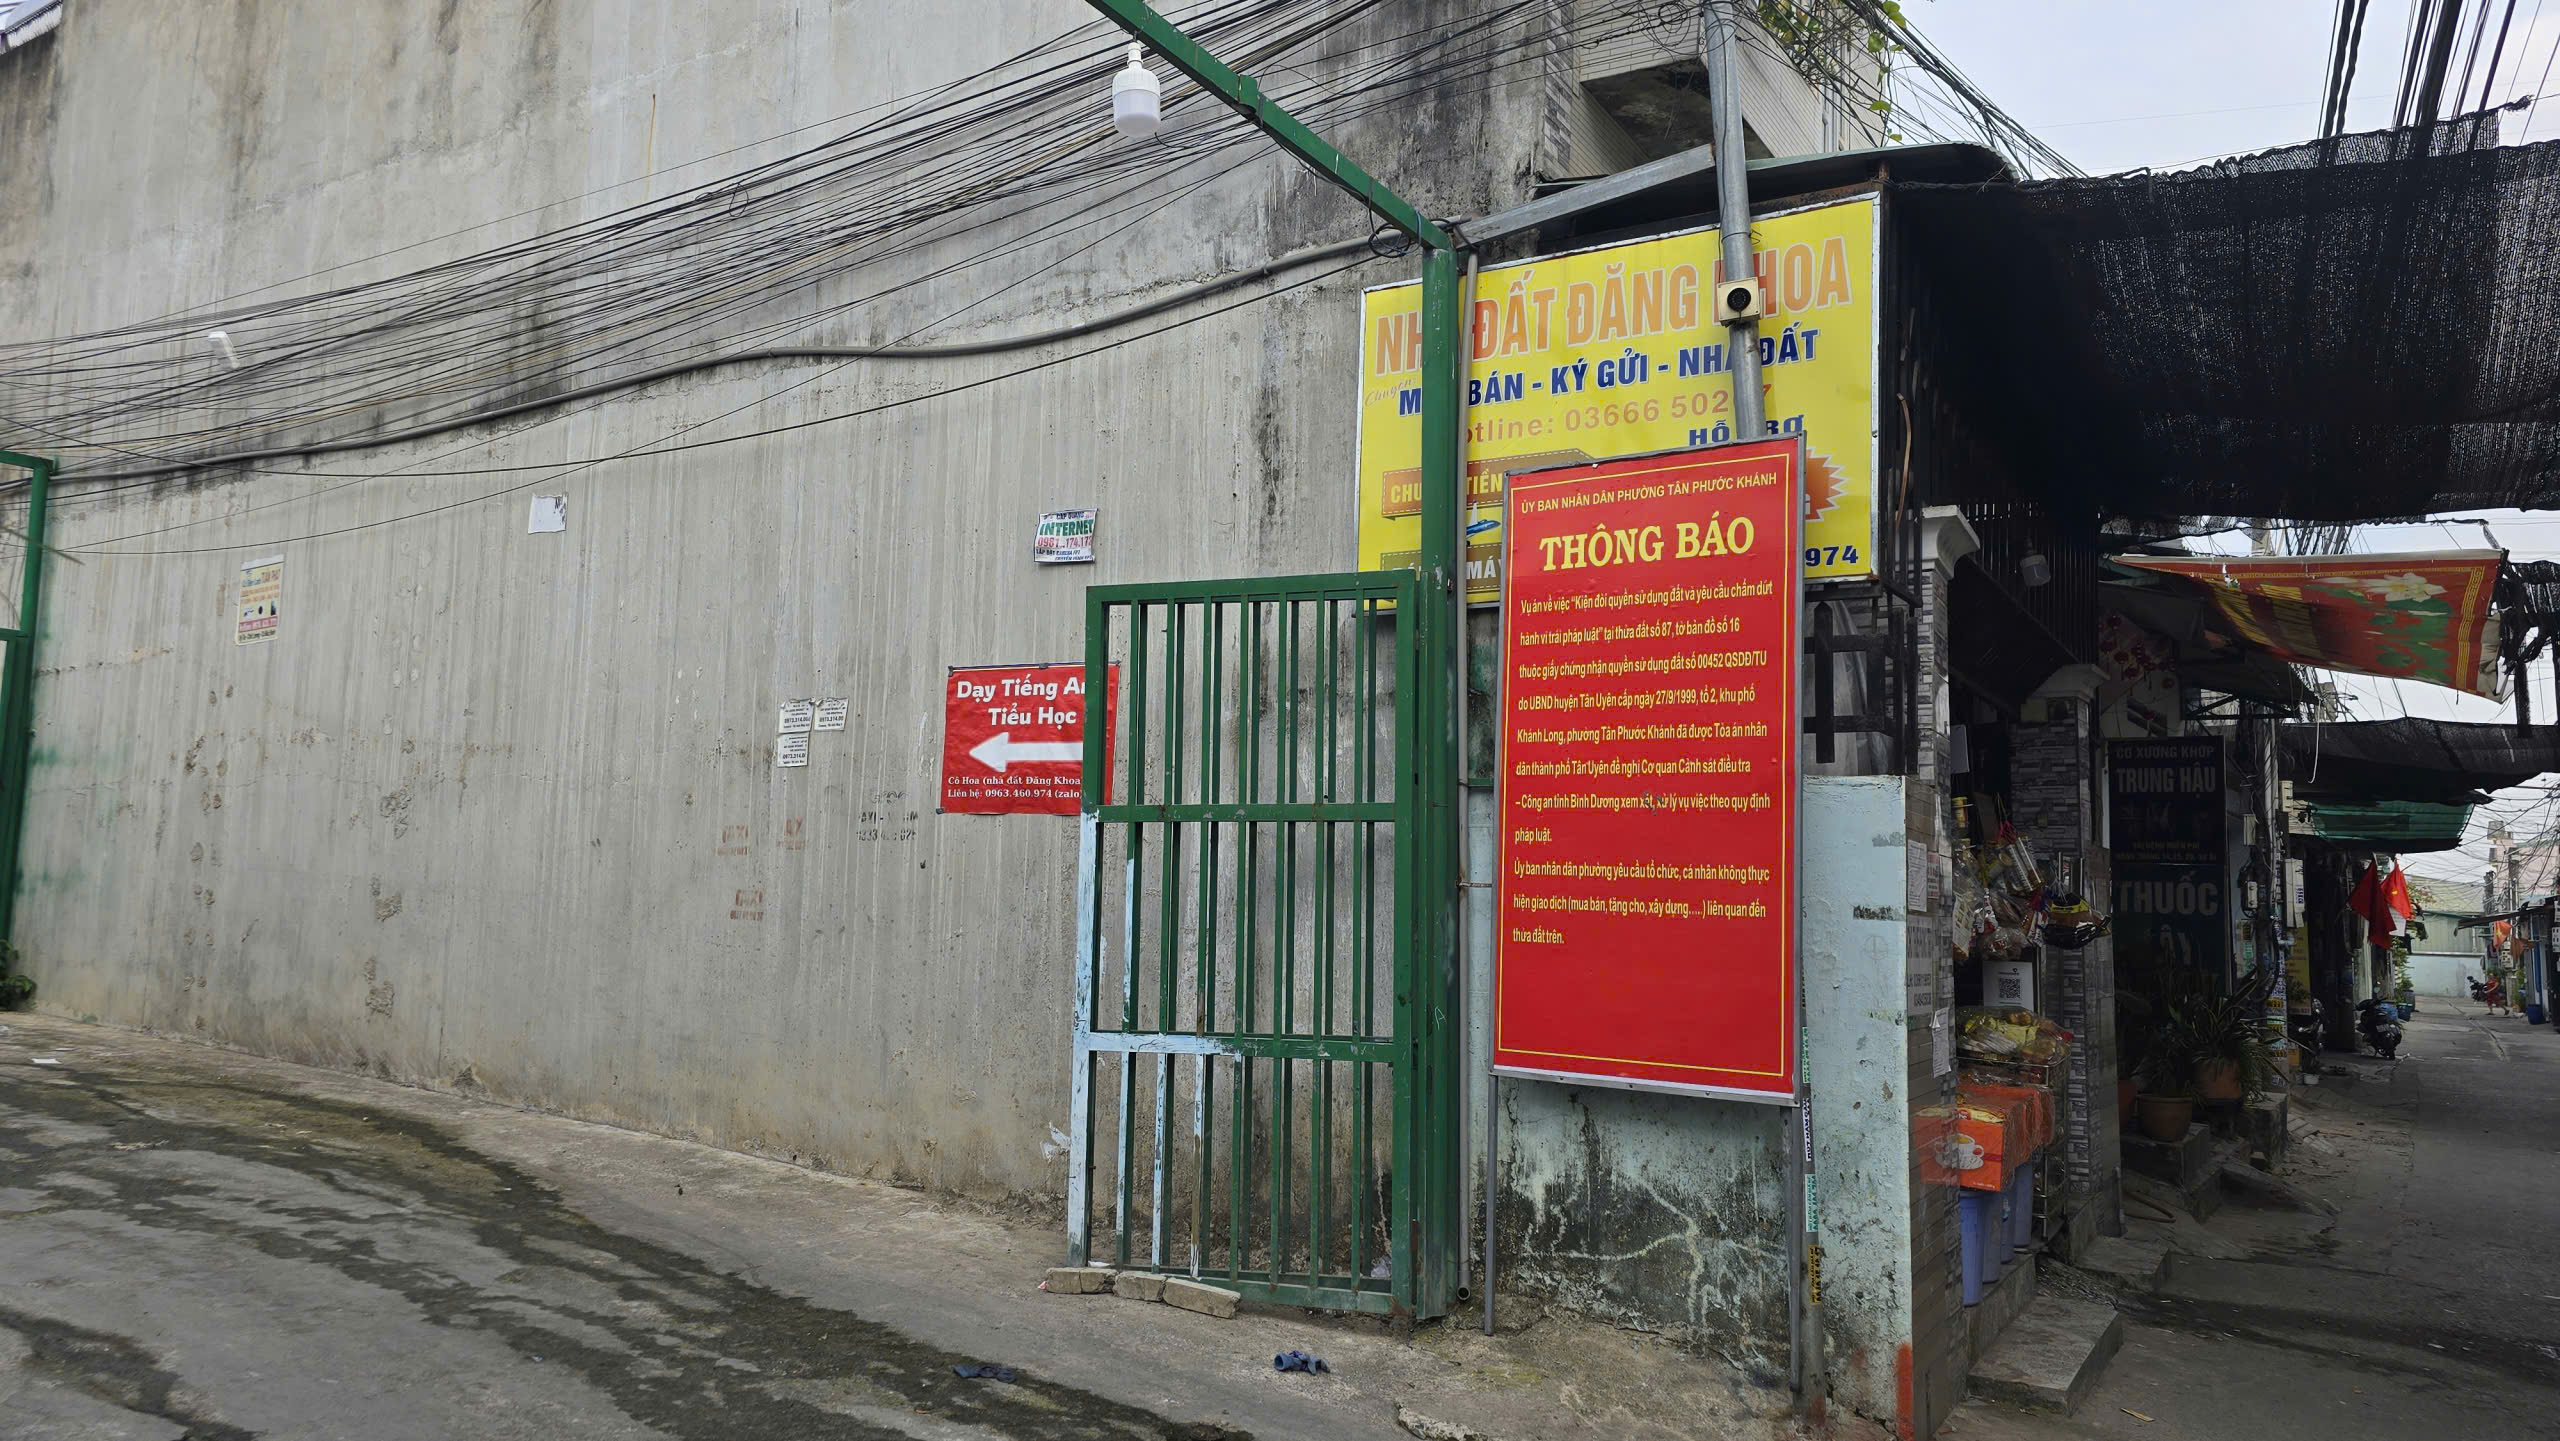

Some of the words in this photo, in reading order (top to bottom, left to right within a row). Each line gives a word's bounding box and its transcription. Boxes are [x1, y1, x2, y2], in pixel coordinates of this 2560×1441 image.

[1567, 262, 1698, 345] ĐĂNG
[1714, 237, 1851, 323] HOA
[1552, 358, 1588, 394] KÝ
[1597, 347, 1649, 388] GỬI
[1566, 398, 1660, 429] 03666
[1521, 499, 1534, 513] ỦY
[1537, 497, 1558, 511] BAN
[1561, 492, 1589, 508] NHÂN
[1592, 489, 1614, 504] DÂN
[1617, 484, 1664, 502] PHƯỜNG
[1667, 480, 1689, 496] TÂN
[1692, 475, 1733, 493] PHƯỚC
[1736, 471, 1776, 488] KHÁNH
[1040, 519, 1094, 536] INTERNET
[1539, 522, 1664, 571] THÔNG
[1675, 510, 1754, 558] BÁO
[1520, 599, 1531, 616] Vụ
[1532, 598, 1542, 612] án
[1543, 594, 1552, 611] về
[1553, 596, 1569, 614] việc
[1594, 592, 1607, 608] đòi
[1608, 587, 1633, 609] quyền
[1634, 589, 1646, 604] sử
[1646, 588, 1668, 606] dụng
[1669, 583, 1683, 602] đất
[1684, 585, 1695, 600] và
[1696, 584, 1712, 604] yêu
[1713, 580, 1729, 598] cầu
[1730, 578, 1755, 597] chấm
[1756, 579, 1772, 595] dứt
[1520, 631, 1539, 645] hành
[1540, 630, 1547, 644] vi
[1548, 629, 1561, 644] trái
[1562, 627, 1582, 646] pháp
[1603, 625, 1614, 643] tại
[1615, 624, 1634, 639] thửa
[1635, 619, 1649, 638] đất
[1649, 618, 1660, 637] số
[1675, 620, 1685, 635] tờ
[1686, 618, 1702, 635] bản
[1703, 615, 1715, 634] đồ
[1716, 614, 1727, 633] số
[1729, 616, 1739, 632] 16
[1519, 663, 1541, 680] thuộc
[1542, 658, 1558, 680] giấy
[1559, 660, 1586, 678] chứng
[1586, 659, 1607, 677] nhận
[1608, 654, 1633, 676] quyền
[1634, 656, 1646, 672] sử
[1647, 656, 1669, 674] dụng
[1670, 651, 1684, 670] đất
[1685, 650, 1696, 669] số
[1697, 652, 1723, 668] 00452
[1724, 649, 1766, 668] QSDĐ/TU
[957, 680, 996, 703] Dạy
[1001, 673, 1058, 701] Tiếng
[1518, 696, 1528, 710] do
[1529, 695, 1553, 710] UBND
[1553, 693, 1578, 712] huyện
[1579, 692, 1594, 707] Tân
[1595, 691, 1616, 710] Uyên
[1617, 688, 1632, 709] cấp
[1633, 690, 1654, 709] ngày
[1699, 684, 1709, 703] tổ
[1719, 687, 1736, 702] khu
[1737, 682, 1755, 705] phố
[988, 702, 1031, 726] Tiểu
[1038, 706, 1077, 730] Học
[1517, 727, 1542, 743] Khánh
[1566, 727, 1599, 744] phường
[1600, 725, 1616, 740] Tân
[1617, 724, 1645, 740] Phước
[1647, 723, 1675, 739] Khánh
[1676, 723, 1687, 739] đã
[1688, 722, 1712, 741] được
[1713, 722, 1730, 737] Tòa
[1731, 721, 1743, 737] án
[1744, 720, 1767, 736] nhân
[962, 776, 980, 785] Hoa
[1006, 775, 1023, 785] đất
[1515, 760, 1530, 775] dân
[1531, 760, 1554, 775] thành
[1554, 756, 1570, 778] phố
[1571, 759, 1586, 774] Tân
[1587, 759, 1608, 778] Uyên
[1609, 755, 1620, 774] đề
[1621, 759, 1640, 778] nghị
[1641, 758, 1654, 774] Cơ
[1655, 761, 1677, 776] quan
[1678, 757, 1701, 773] Cảnh
[1702, 757, 1716, 773] sát
[1717, 753, 1737, 772] điều
[1737, 757, 1750, 772] tra
[2115, 767, 2176, 793] TRUNG
[985, 788, 1052, 798] 0963.460.974
[1514, 826, 1534, 845] pháp
[1514, 856, 1524, 878] Ủy
[1525, 860, 1540, 875] ban
[1541, 860, 1561, 875] nhân
[1562, 860, 1577, 876] dân
[1578, 861, 1612, 880] phường
[1613, 861, 1628, 881] yêu
[1629, 859, 1645, 878] cầu
[1646, 859, 1655, 878] tổ
[1682, 863, 1693, 879] cá
[1694, 863, 1716, 879] nhân
[1718, 864, 1746, 884] không
[1747, 864, 1769, 884] thực
[1513, 893, 1530, 911] hiện
[1531, 894, 1548, 912] giao
[1549, 894, 1566, 912] dịch
[1608, 896, 1627, 916] tặng
[1648, 897, 1663, 917] xây
[1707, 899, 1723, 915] liên
[1724, 904, 1747, 920] quan
[1748, 897, 1765, 917] đến
[2115, 869, 2219, 917] THUỐC
[1512, 927, 1531, 942] thừa
[1532, 924, 1545, 943] đất
